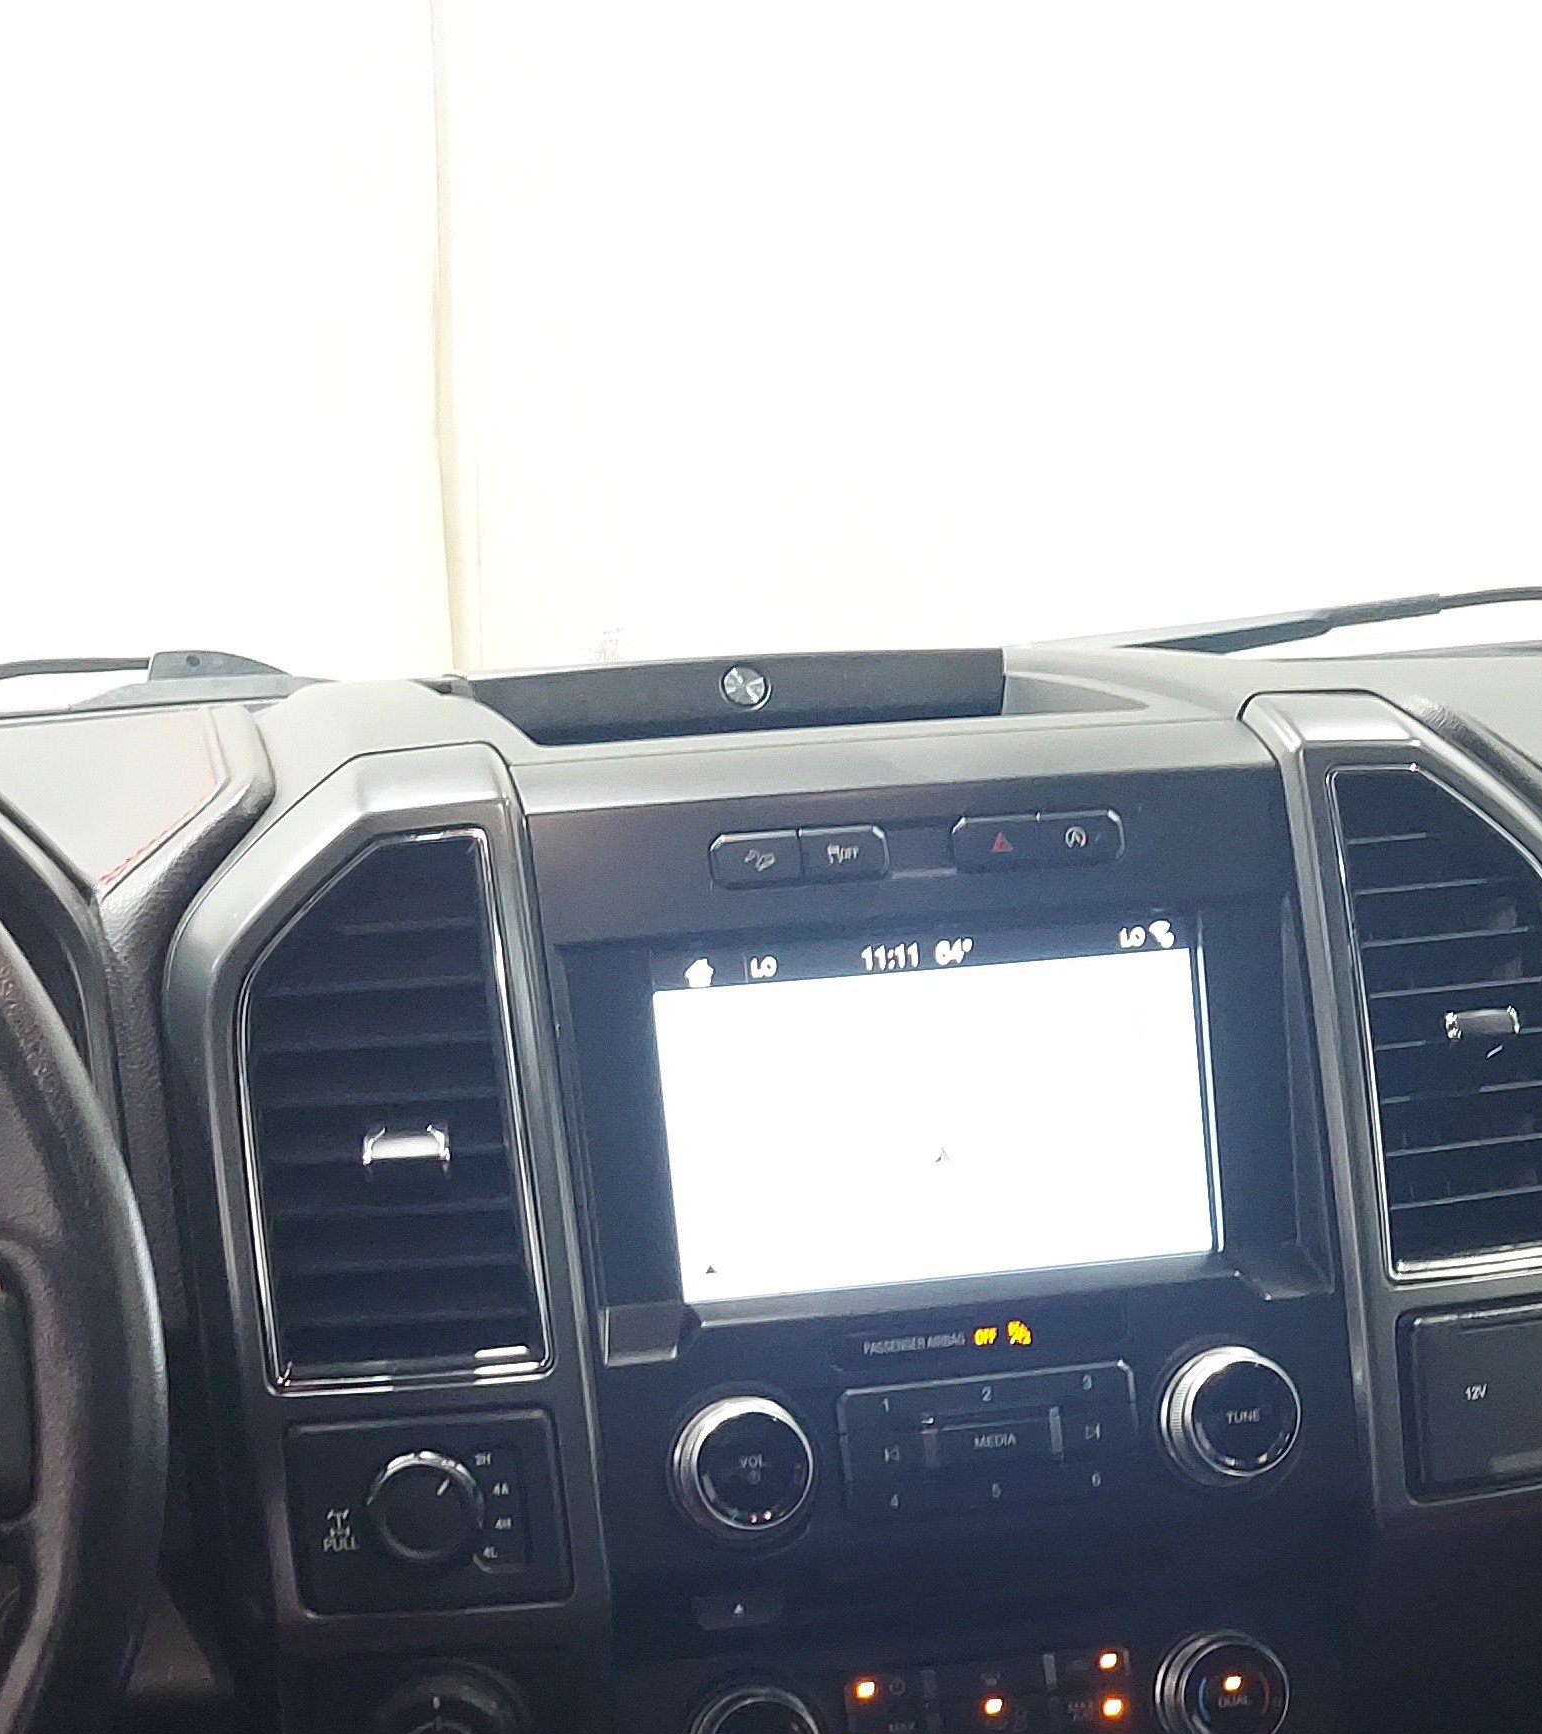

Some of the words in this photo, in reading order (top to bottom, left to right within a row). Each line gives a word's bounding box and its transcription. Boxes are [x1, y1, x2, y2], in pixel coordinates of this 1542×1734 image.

[861, 940, 920, 971] 11:11
[974, 1327, 998, 1346] OFF
[982, 1386, 993, 1402] 2
[1464, 1383, 1488, 1401] 12V
[1225, 1408, 1261, 1424] TUNE
[974, 1432, 1017, 1449] MEDIA
[739, 1454, 765, 1468] VOL
[323, 1536, 356, 1552] PULL
